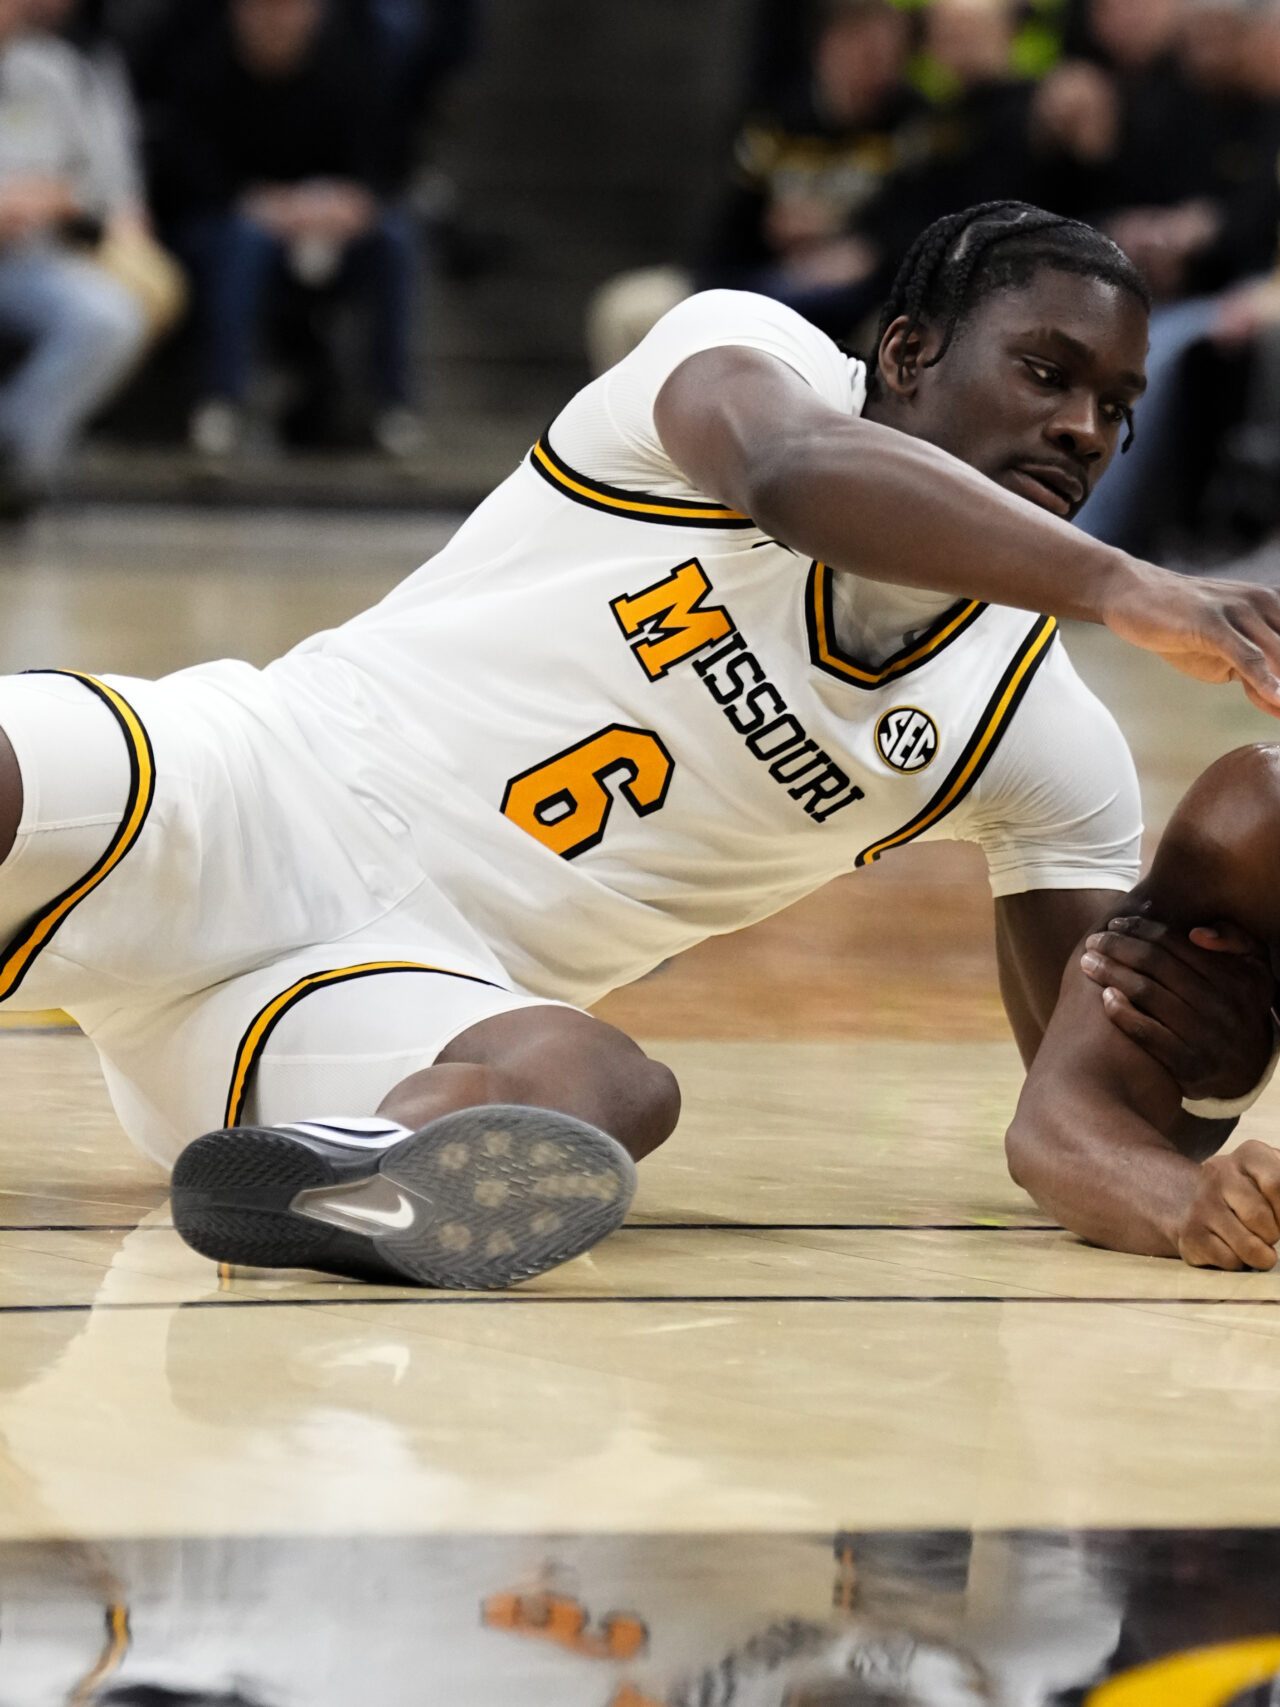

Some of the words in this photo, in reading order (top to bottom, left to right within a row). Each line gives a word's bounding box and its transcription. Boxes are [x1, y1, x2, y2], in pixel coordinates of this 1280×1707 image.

[609, 557, 865, 823] MISSOURI
[880, 710, 934, 770] SEC
[499, 722, 677, 861] 6
